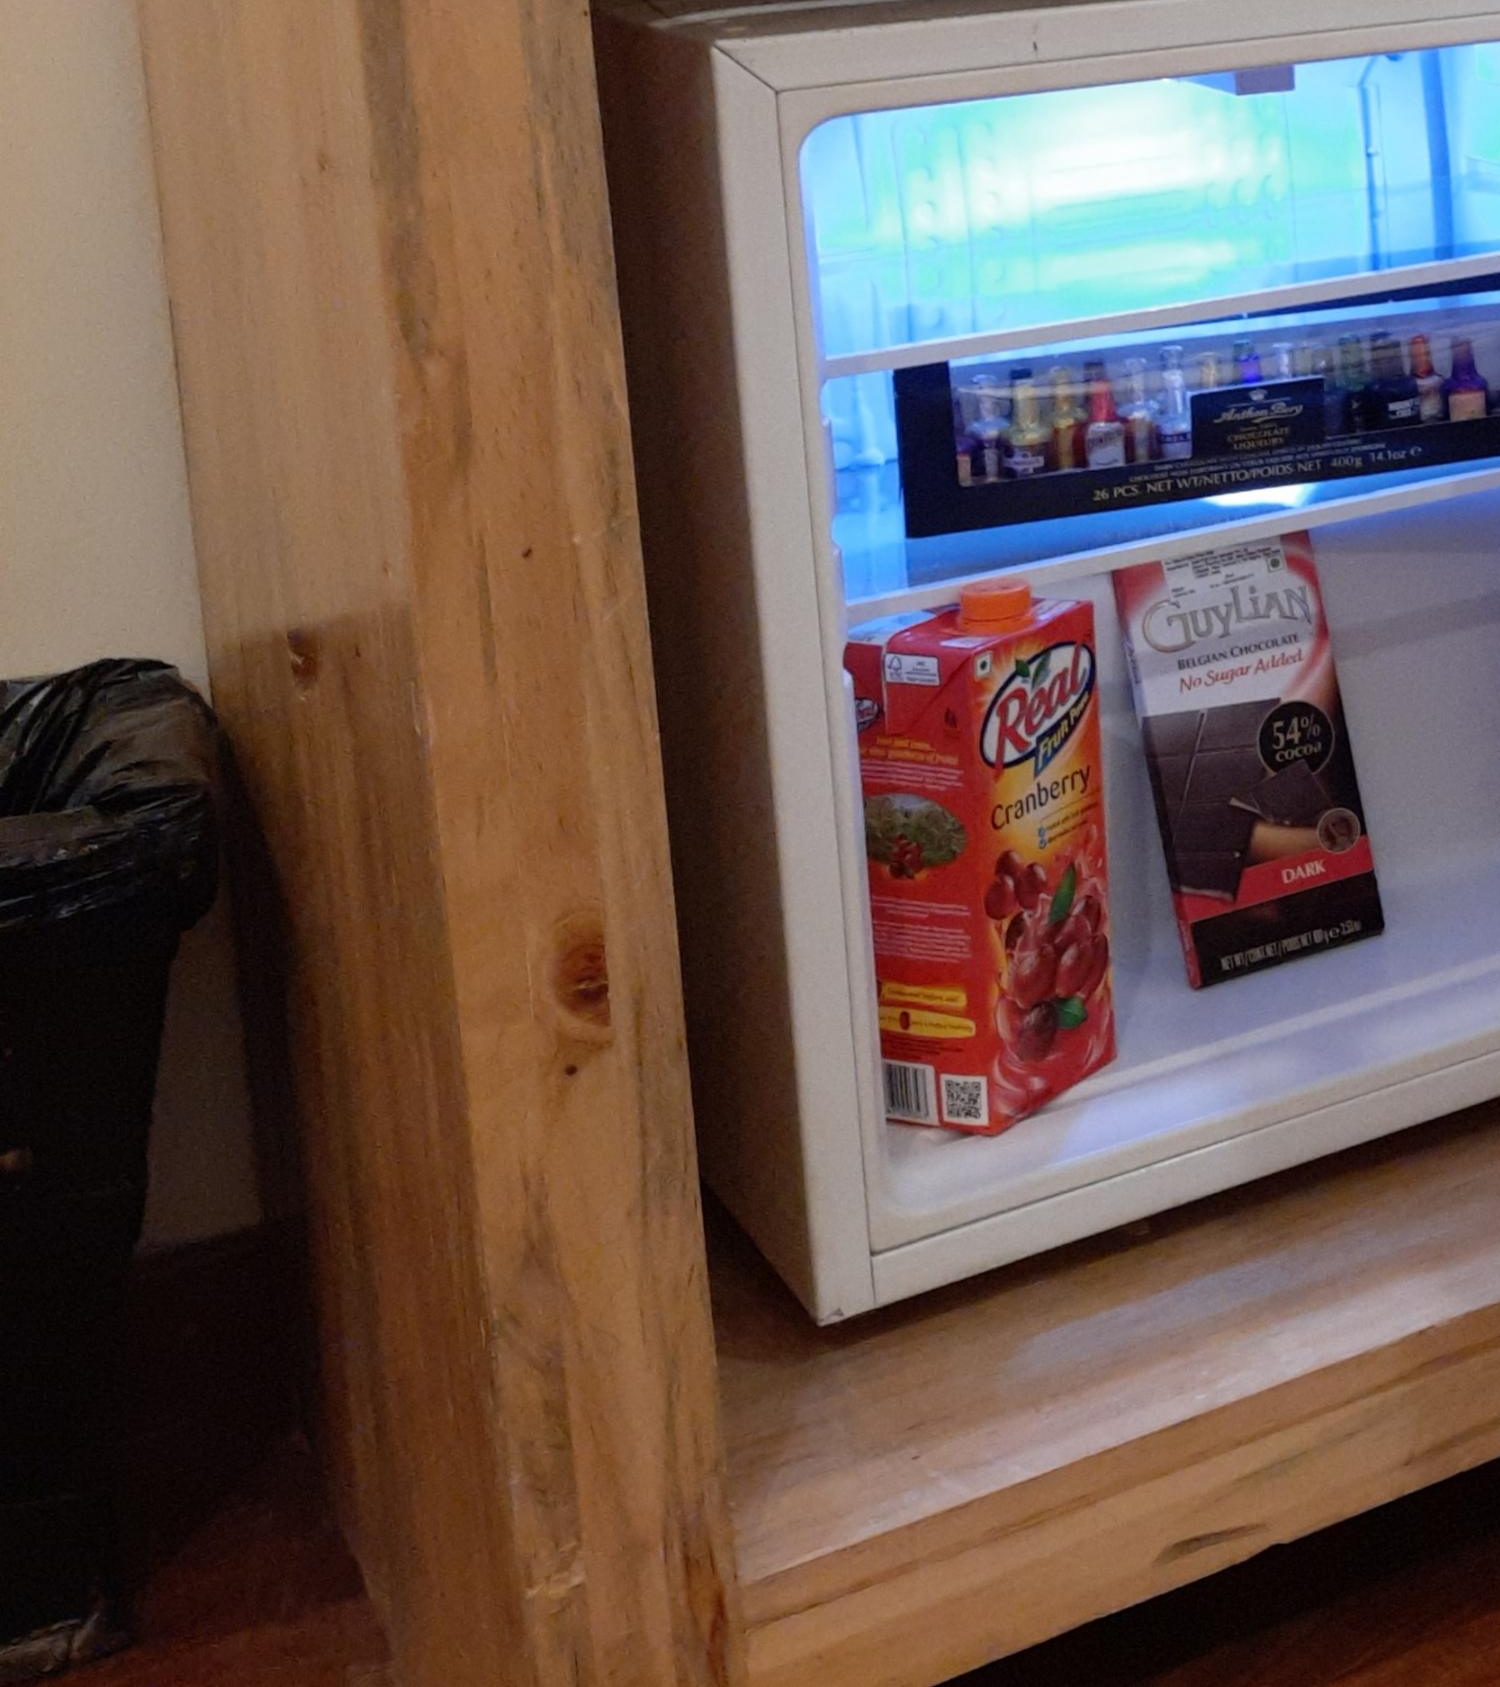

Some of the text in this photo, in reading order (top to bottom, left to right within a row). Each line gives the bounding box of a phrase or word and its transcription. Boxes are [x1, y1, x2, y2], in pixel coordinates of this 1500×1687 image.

[1146, 479, 1174, 494] NET
[1297, 458, 1322, 472] NET
[1177, 633, 1301, 671] BELGIAN CHOCOLATE
[1179, 648, 1306, 694] No Sugar Added
[994, 641, 1088, 780] Real
[1271, 713, 1321, 750] 54%
[991, 764, 1092, 831] Cranberry
[1281, 858, 1328, 885] DARK
